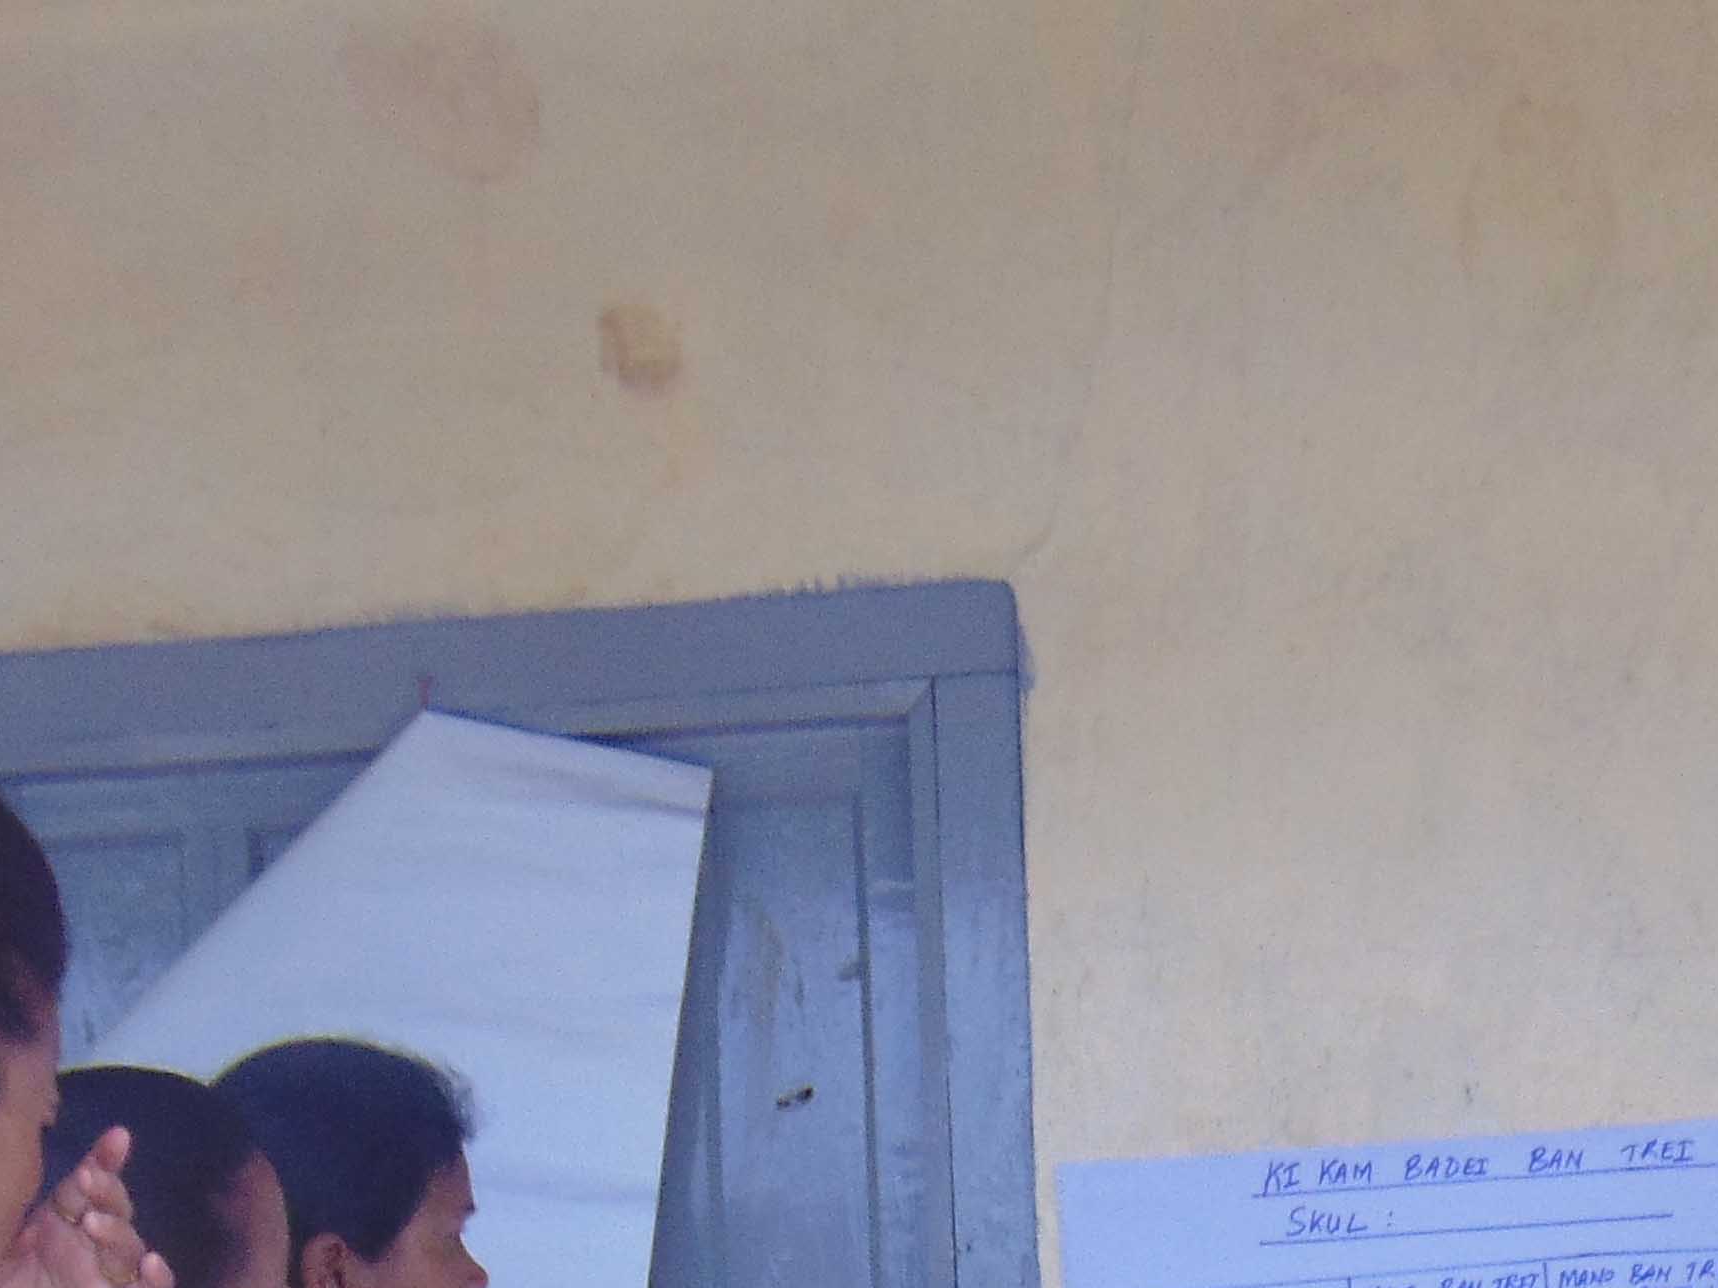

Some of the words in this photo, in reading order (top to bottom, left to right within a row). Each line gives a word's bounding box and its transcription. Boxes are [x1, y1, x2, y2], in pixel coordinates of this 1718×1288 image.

[1262, 1161, 1300, 1196] KI
[1319, 1159, 1372, 1185] KAM
[1404, 1154, 1490, 1181] BADEI
[1528, 1146, 1584, 1173] BAN
[1621, 1138, 1693, 1163] TREI
[1286, 1207, 1367, 1237] SKUL
[1629, 1263, 1672, 1285] BAN
